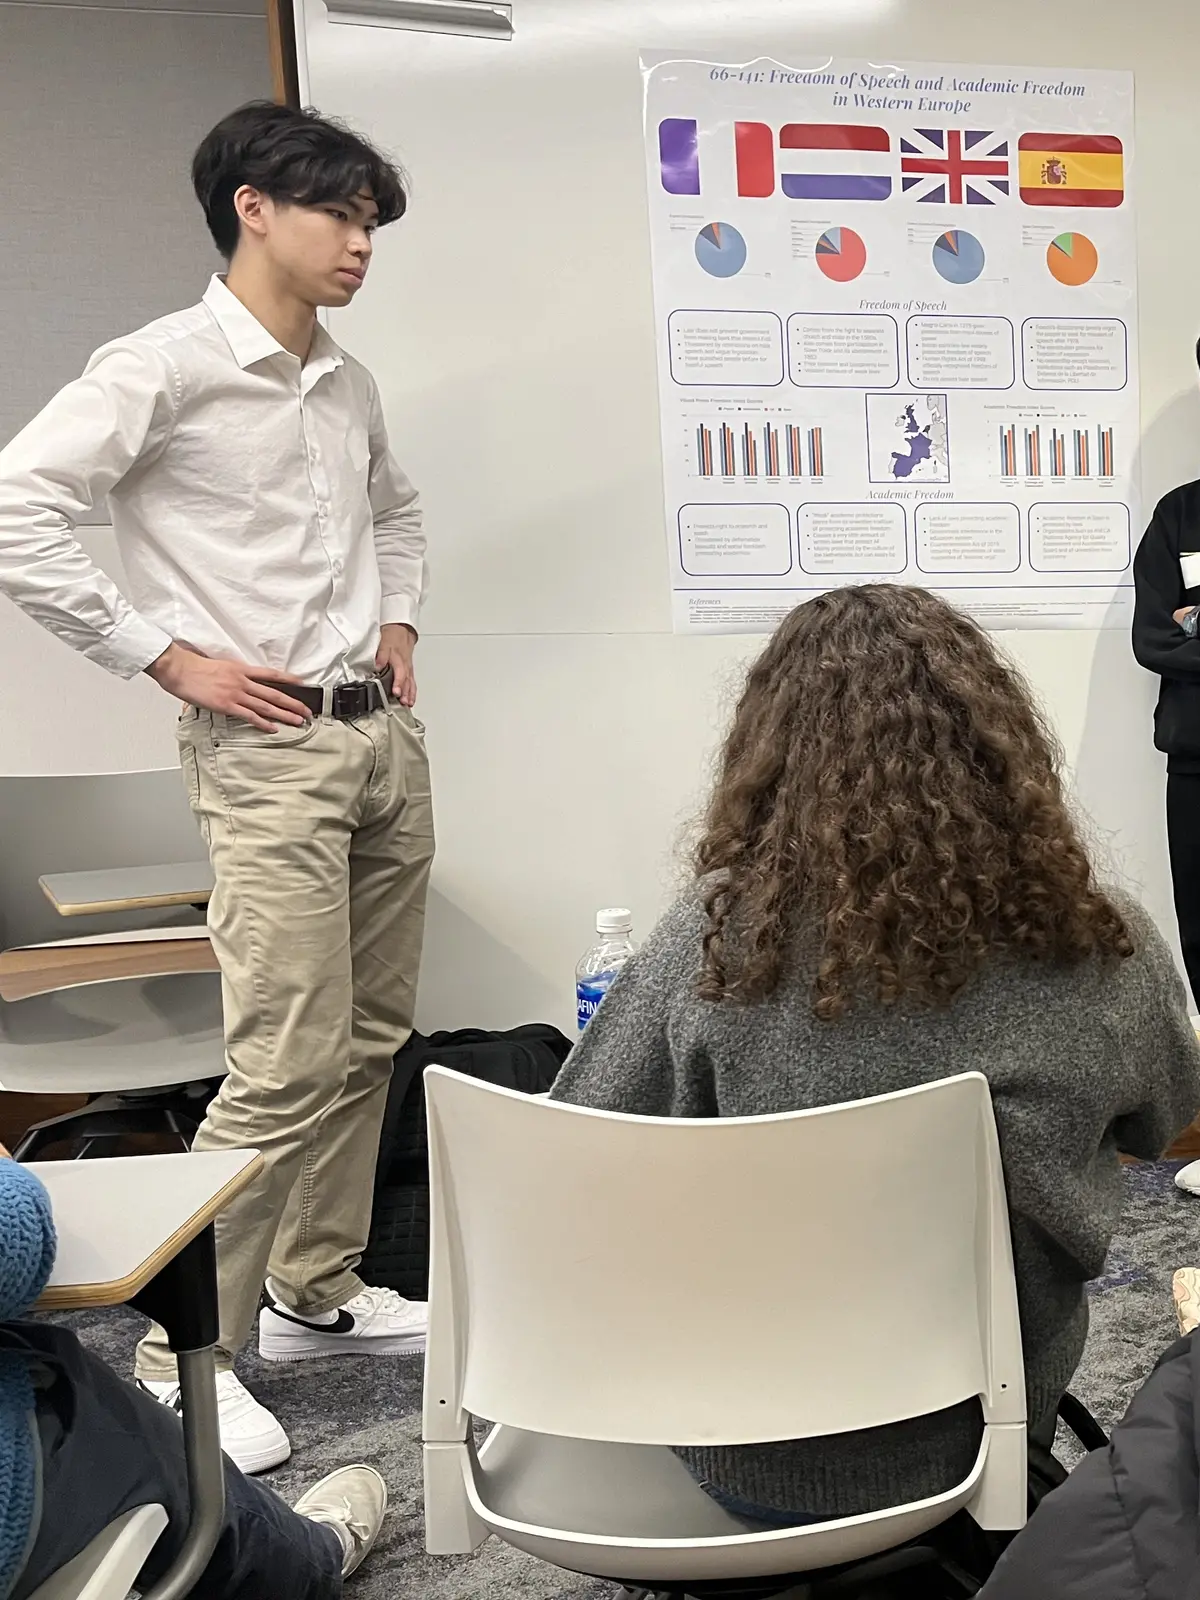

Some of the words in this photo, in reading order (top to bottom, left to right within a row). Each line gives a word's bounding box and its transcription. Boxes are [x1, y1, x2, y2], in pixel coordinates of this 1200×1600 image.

[709, 68, 764, 84] 66-141:
[769, 69, 834, 86] Freedom
[840, 72, 856, 88] of
[858, 72, 909, 90] Speech
[915, 77, 944, 92] and
[946, 78, 1019, 94] Academic
[1023, 81, 1085, 97] Freedom
[833, 92, 847, 106] in
[853, 93, 913, 110] Western
[917, 97, 971, 114] Europe
[859, 300, 901, 310] Freedom
[903, 300, 914, 312] of
[915, 301, 947, 312] Speech
[865, 489, 912, 499] Academic
[915, 490, 954, 499] Freedom
